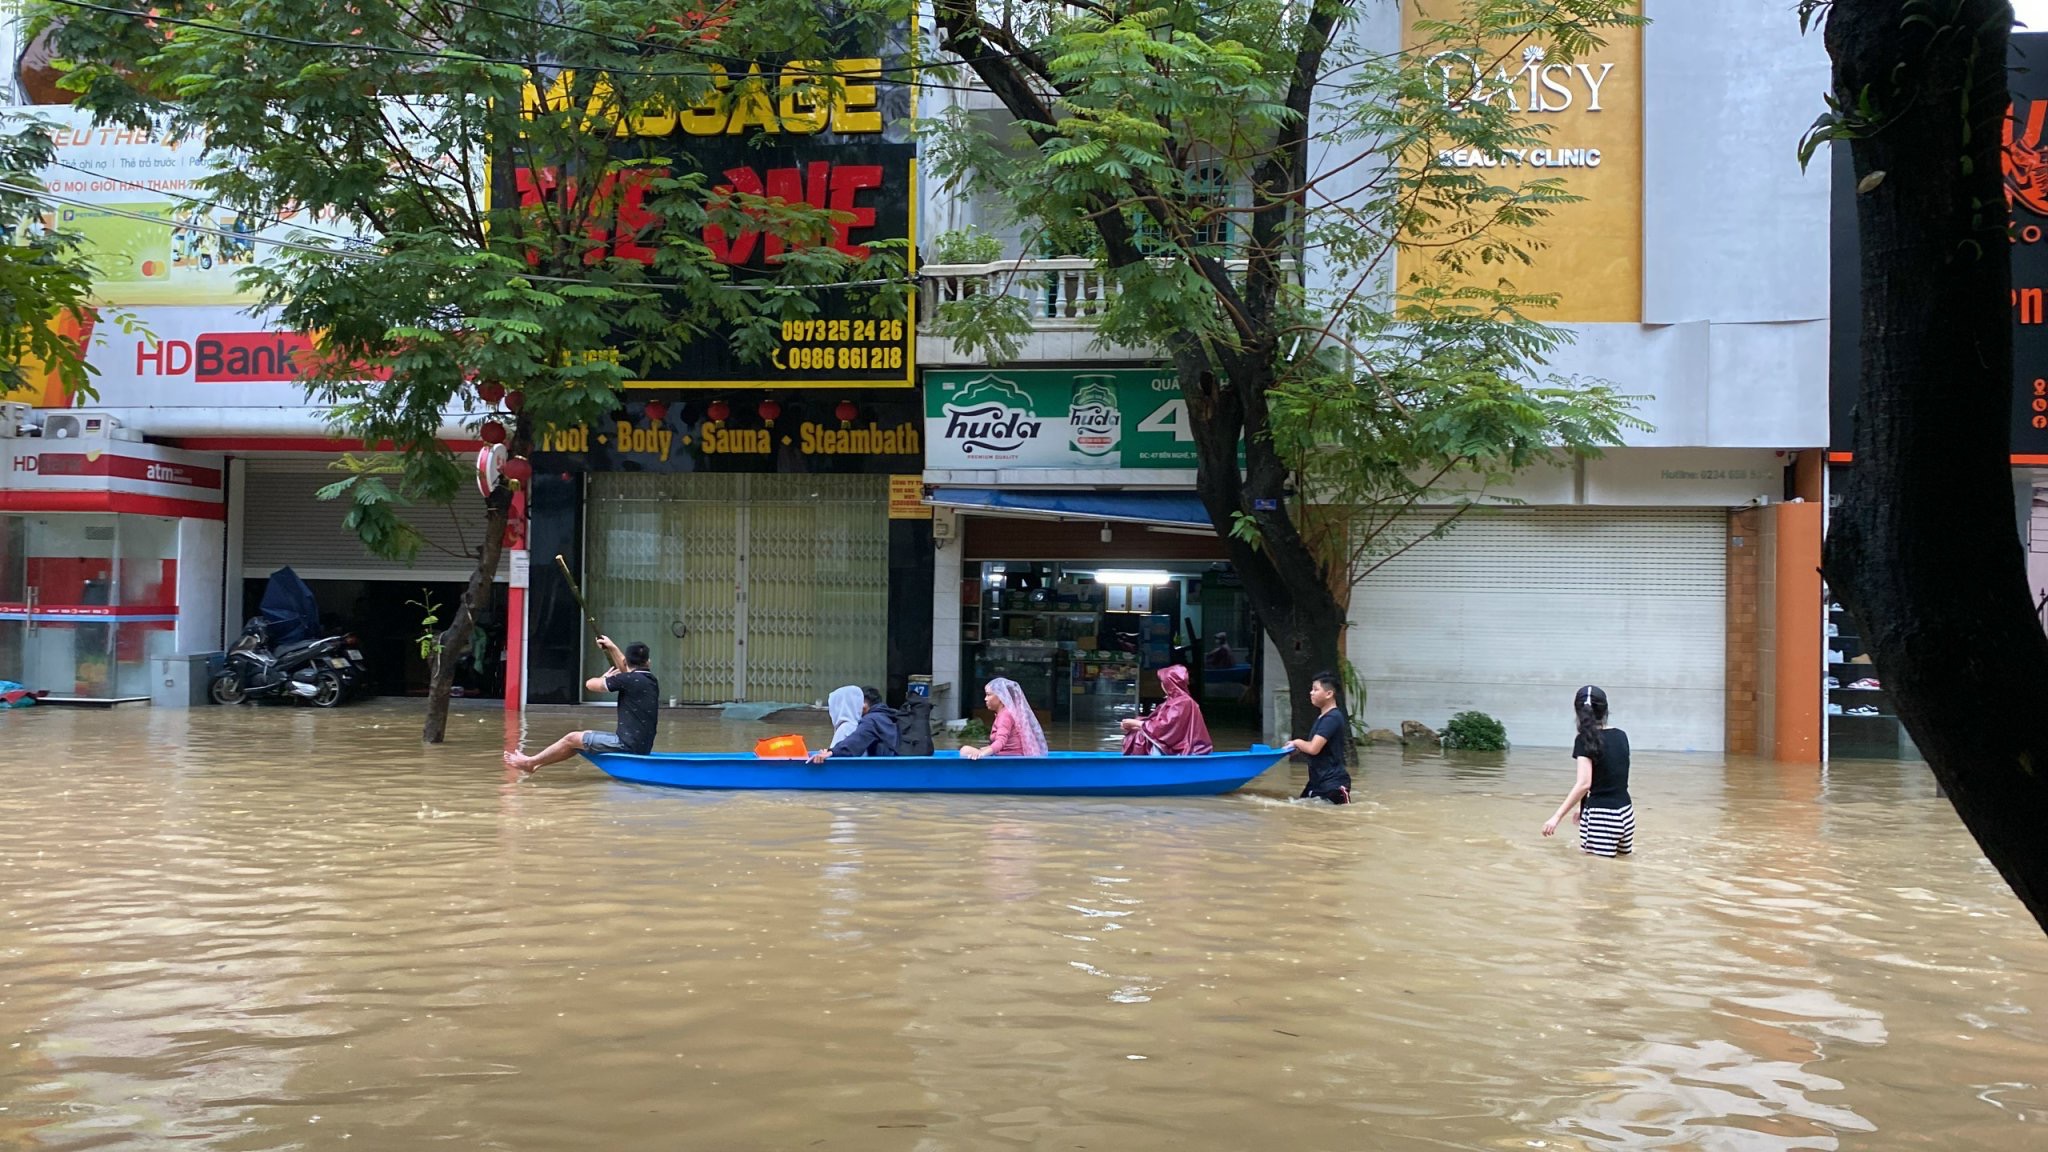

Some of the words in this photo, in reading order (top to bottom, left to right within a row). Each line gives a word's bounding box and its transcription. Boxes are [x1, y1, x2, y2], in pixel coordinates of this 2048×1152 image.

[1424, 46, 1614, 112] DAISY
[1438, 149, 1527, 167] BEAUTY
[1530, 149, 1601, 167] CLINIC
[853, 320, 876, 341] 24
[879, 320, 903, 341] 26
[136, 339, 300, 376] HDBank
[789, 347, 835, 370] 0986
[838, 347, 868, 370] 861
[871, 347, 902, 370] 218
[945, 406, 1042, 439] huda
[1070, 405, 1120, 426] huda
[616, 420, 673, 462] Body
[701, 421, 771, 454] Sauna
[800, 421, 920, 454] Steambath
[146, 463, 174, 481] atm
